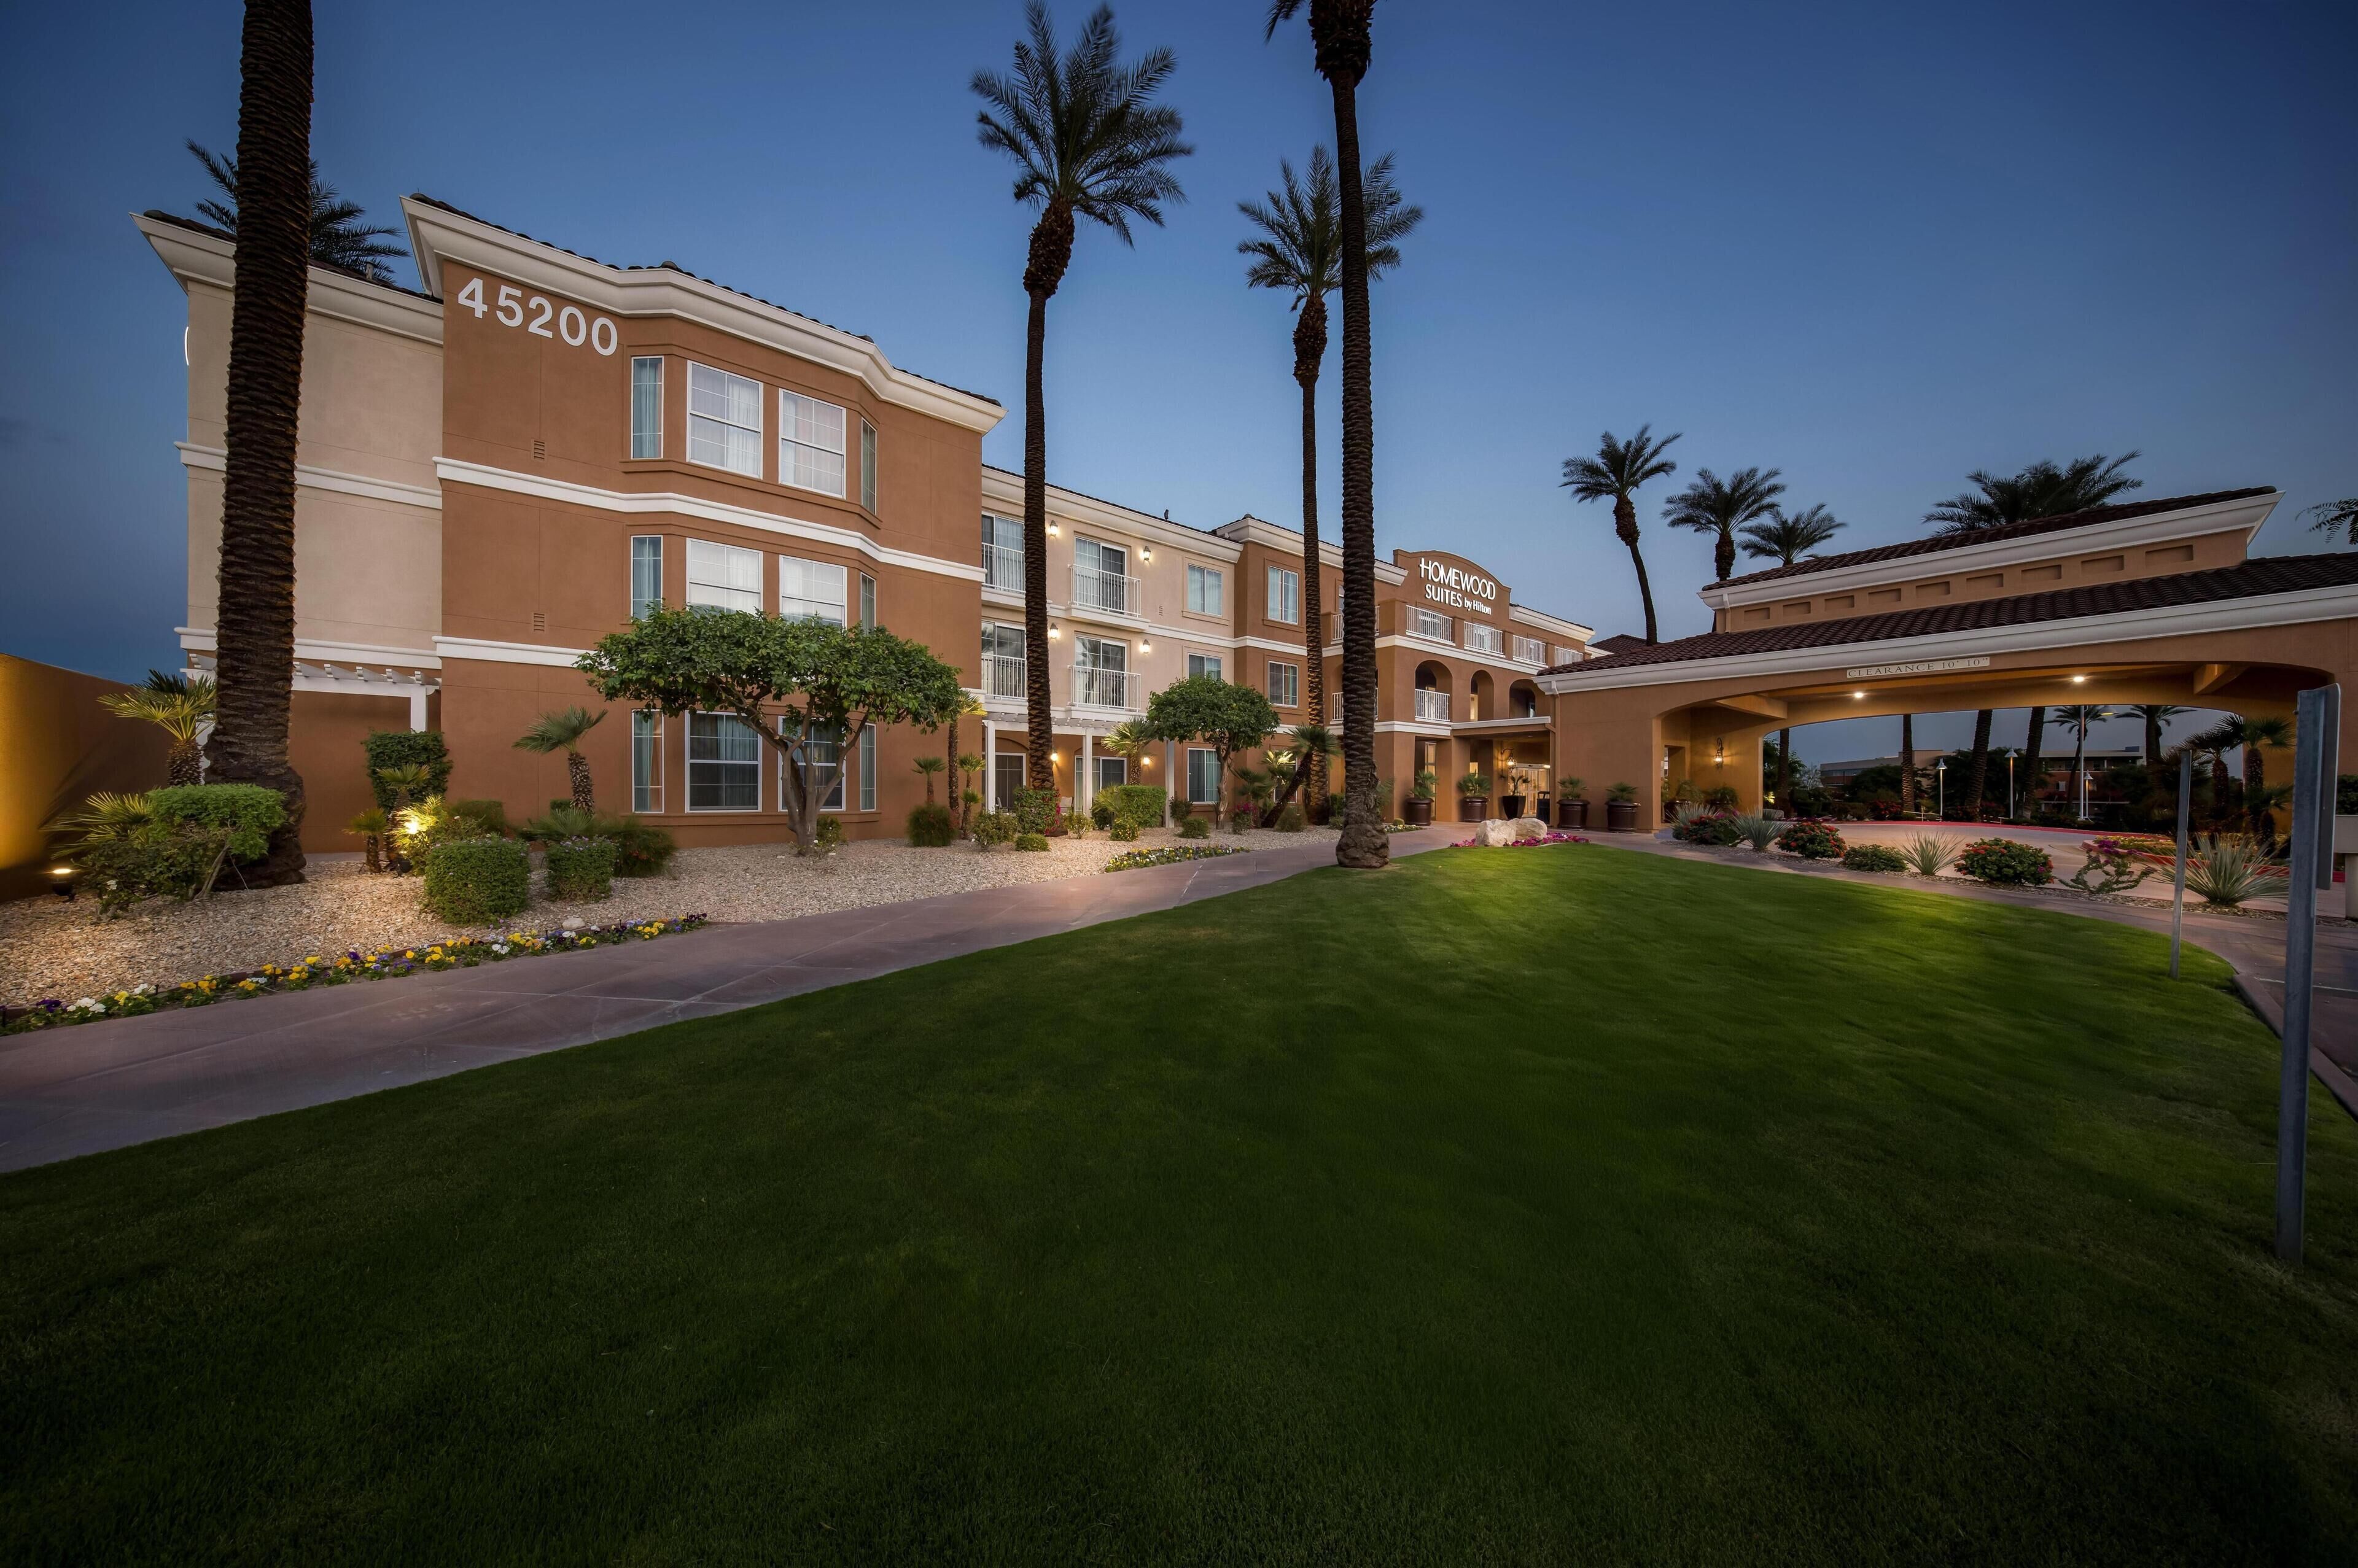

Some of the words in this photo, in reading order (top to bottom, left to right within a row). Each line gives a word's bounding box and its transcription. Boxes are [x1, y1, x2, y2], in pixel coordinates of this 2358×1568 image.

[458, 278, 618, 356] 45200
[1419, 557, 1496, 600] HOMEWOOD
[1425, 584, 1462, 608] SUITES
[1464, 597, 1472, 611] by
[1473, 600, 1492, 615] Hilton
[1848, 663, 1934, 677] CLEARANCE
